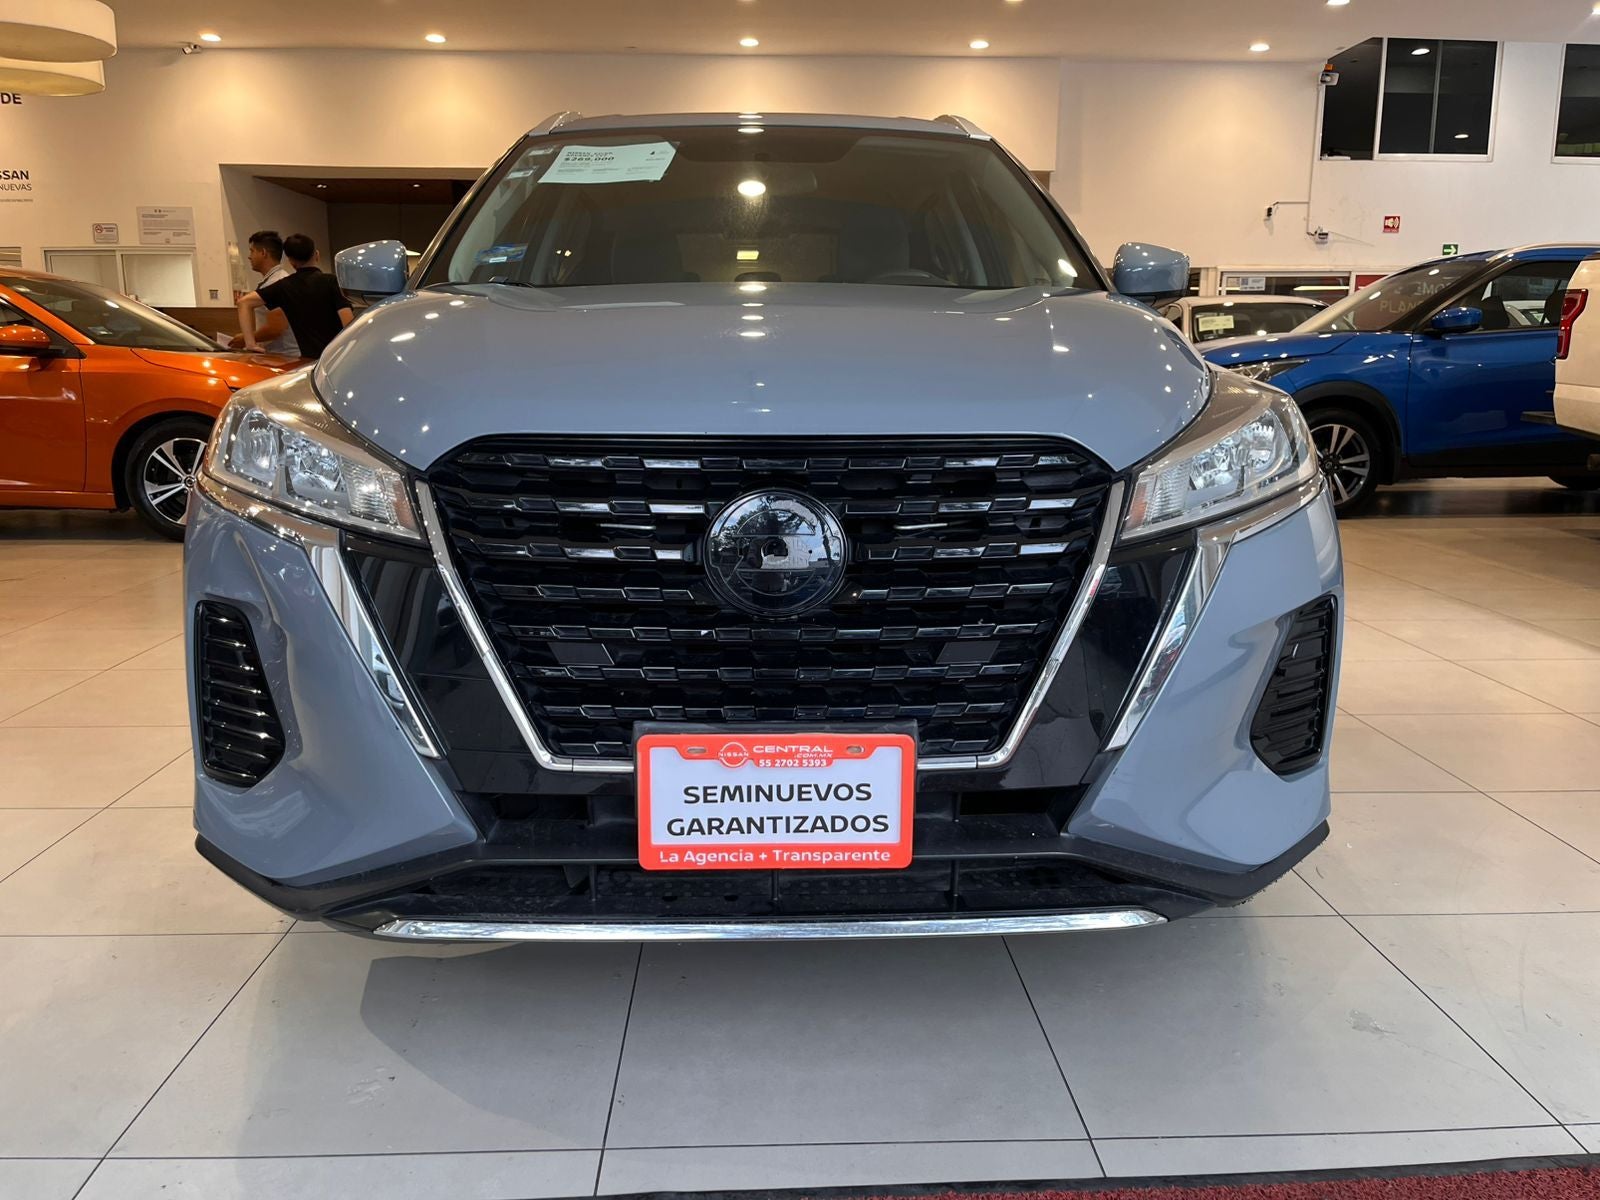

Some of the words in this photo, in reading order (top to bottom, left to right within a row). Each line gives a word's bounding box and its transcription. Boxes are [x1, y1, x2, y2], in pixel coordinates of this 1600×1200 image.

[1, 92, 22, 104] DE
[0, 170, 29, 180] SSAN
[753, 745, 833, 753] CENTRAL
[759, 759, 771, 767] 55
[774, 759, 799, 767] 2702
[802, 758, 827, 767] 5393
[683, 783, 872, 804] SEMINUEVOS
[667, 814, 889, 837] GARANTIZADOS
[659, 850, 679, 863] La
[683, 849, 754, 866] Agencia
[759, 852, 768, 861] +
[772, 849, 891, 864] Transparente
